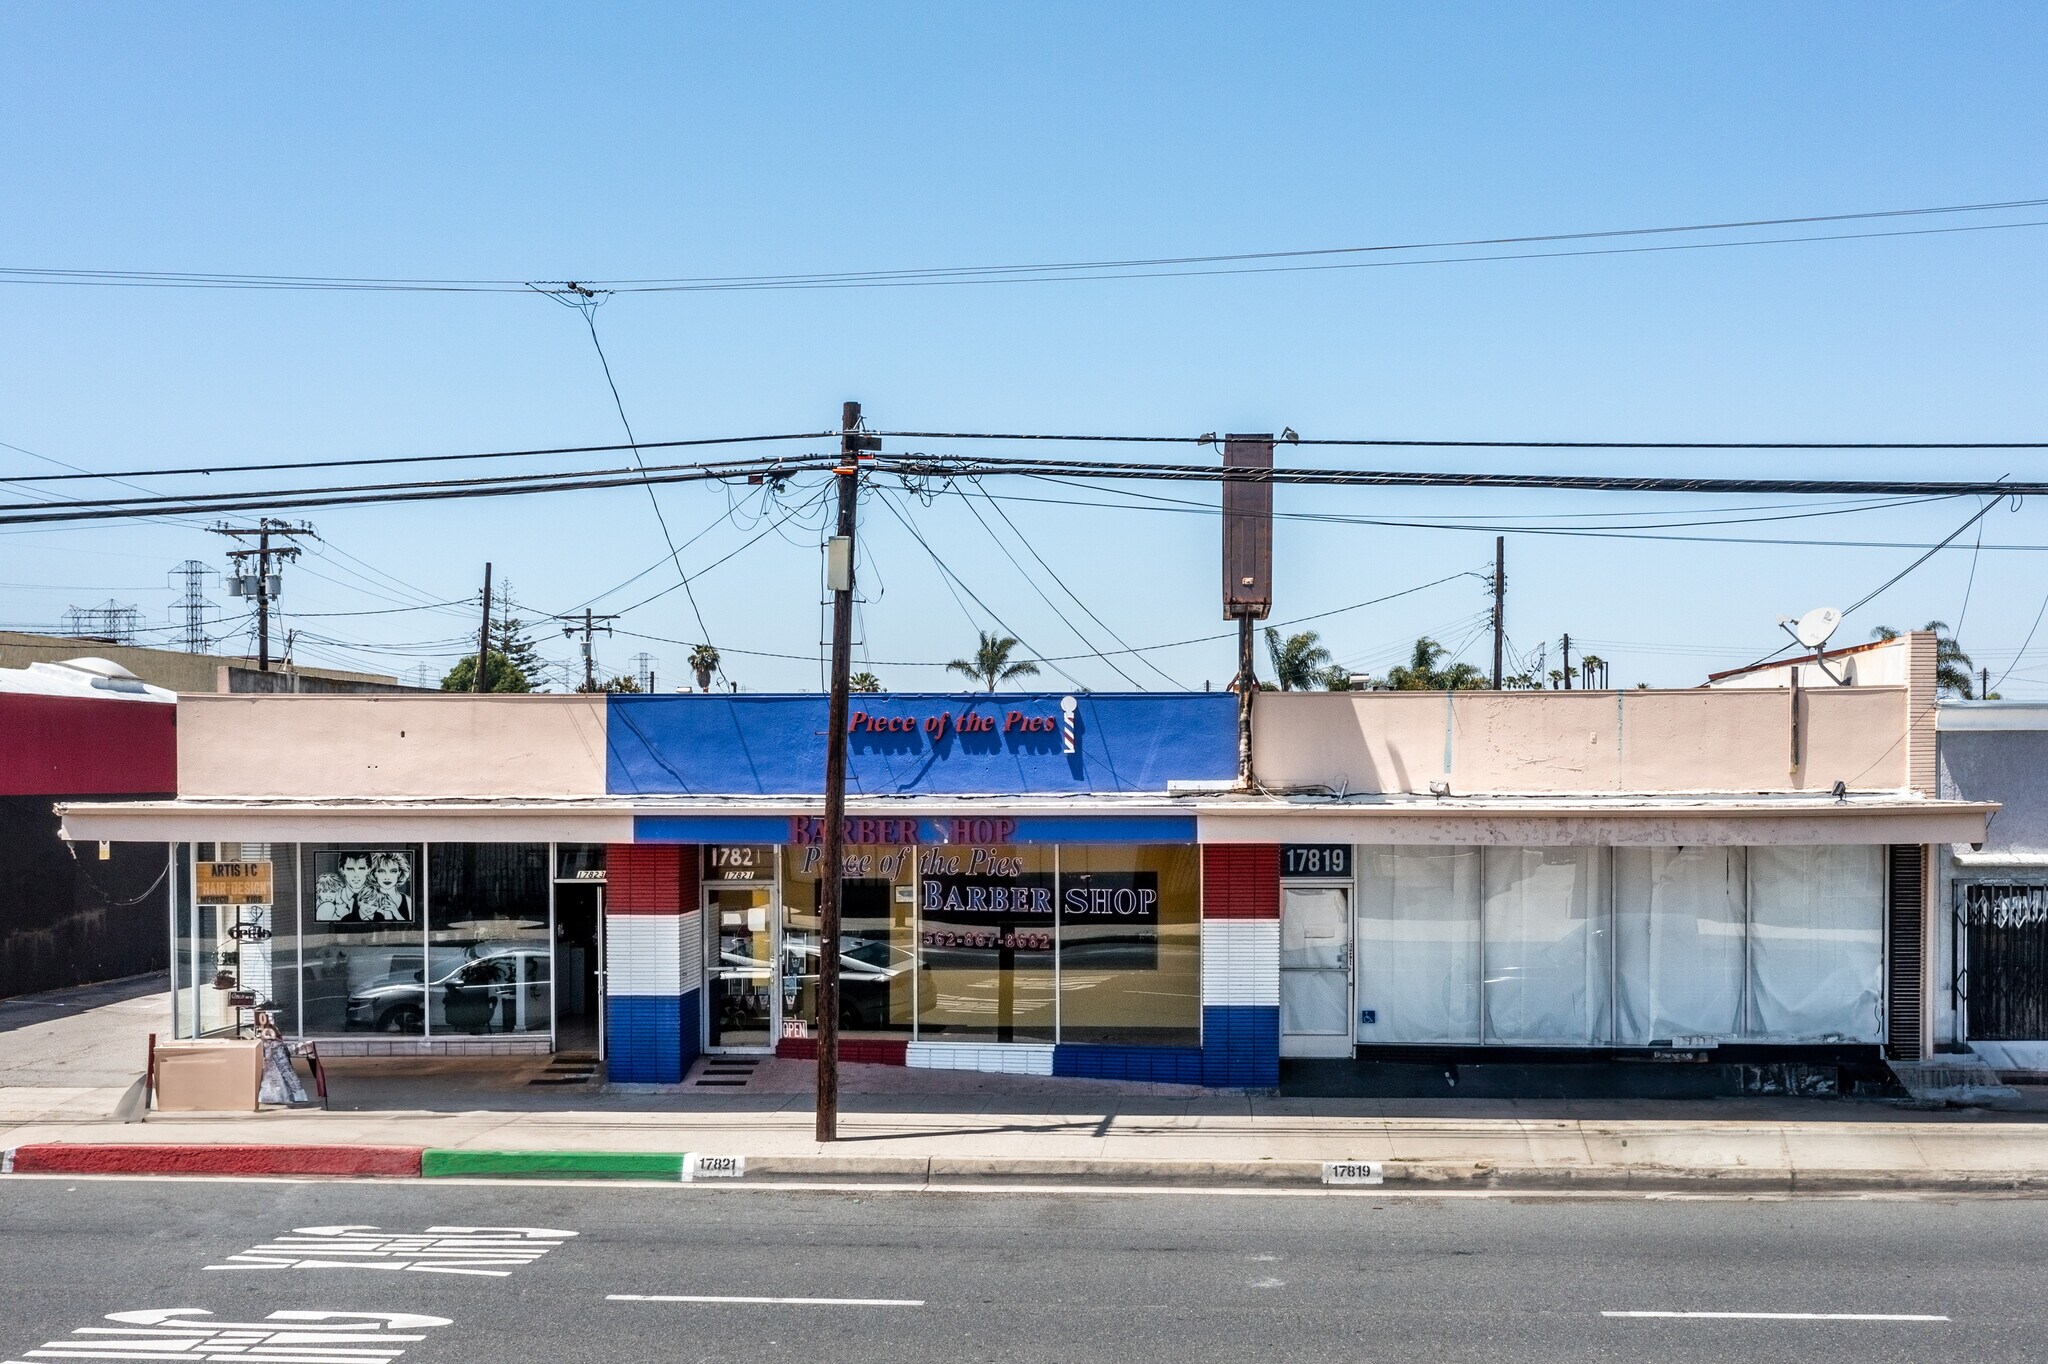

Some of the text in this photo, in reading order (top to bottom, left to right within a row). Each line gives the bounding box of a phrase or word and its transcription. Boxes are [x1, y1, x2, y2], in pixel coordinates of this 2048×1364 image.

[848, 711, 1055, 740] Piece of the Pies
[950, 818, 1016, 845] HOP
[801, 845, 1024, 882] Pce of the Pies
[1286, 848, 1345, 873] 17819
[923, 880, 1157, 915] BARBER SHOP
[923, 931, 1051, 949] 562-867-8682
[782, 1022, 806, 1038] OPEN
[700, 1157, 736, 1171] 17821
[1333, 1165, 1371, 1178] 17819
